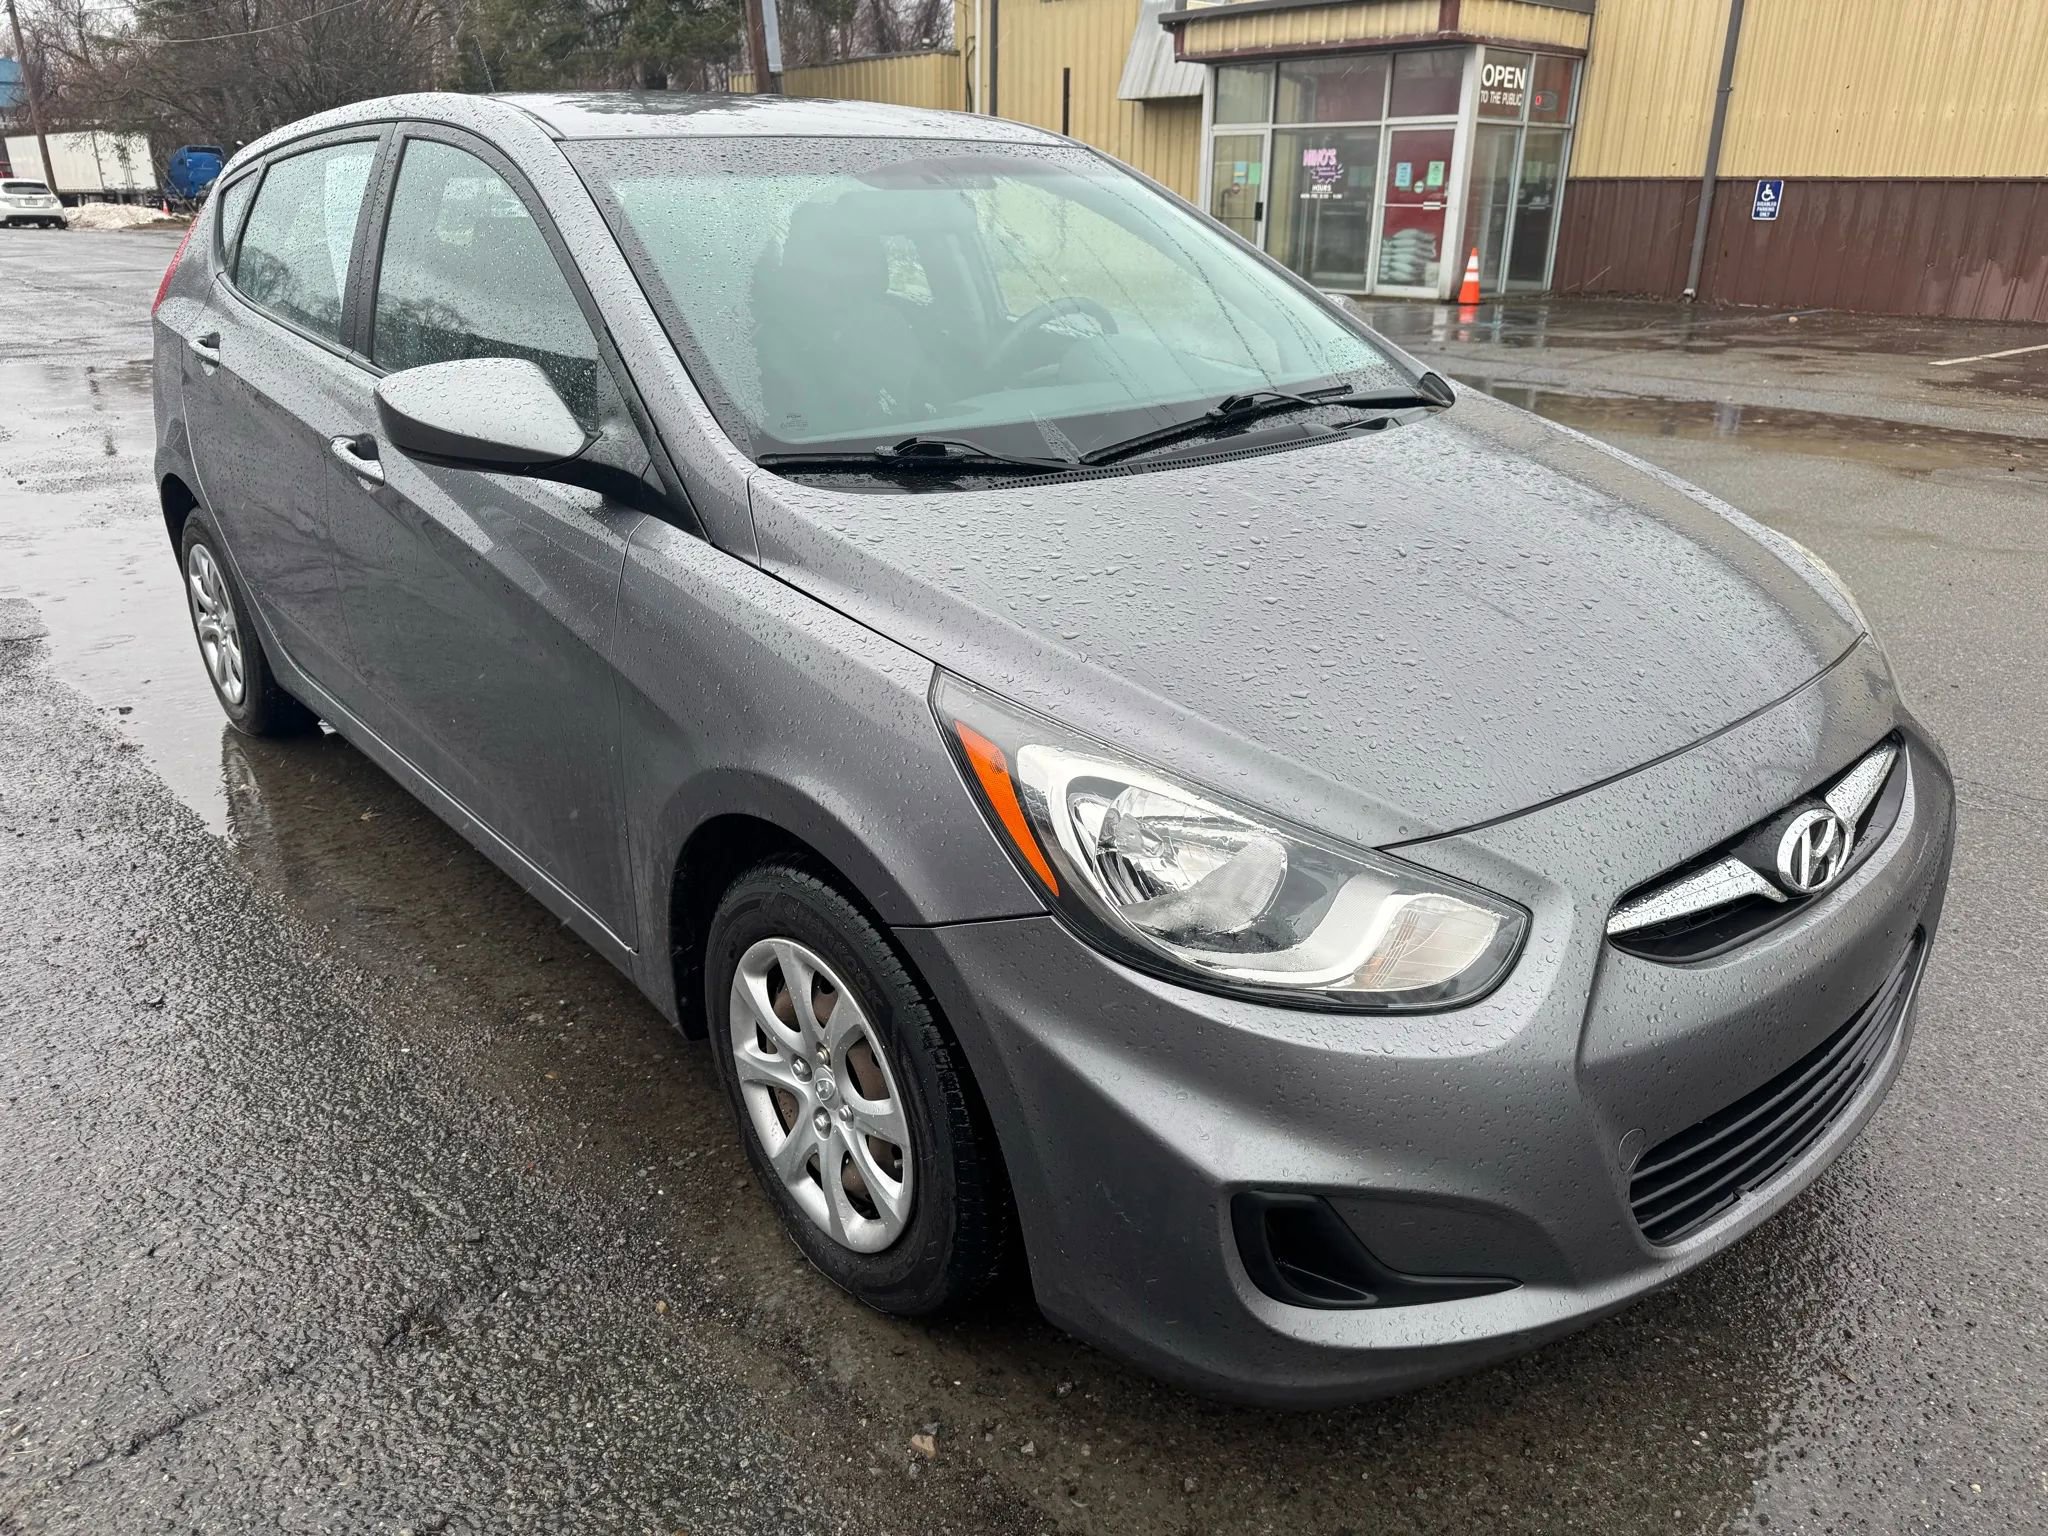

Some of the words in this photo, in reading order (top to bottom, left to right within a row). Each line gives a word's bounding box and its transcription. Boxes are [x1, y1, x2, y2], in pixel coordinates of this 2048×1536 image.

[1482, 64, 1526, 89] OPEN
[1480, 90, 1489, 103] TO
[1490, 91, 1502, 104] THE
[1502, 92, 1523, 106] PUBLIC
